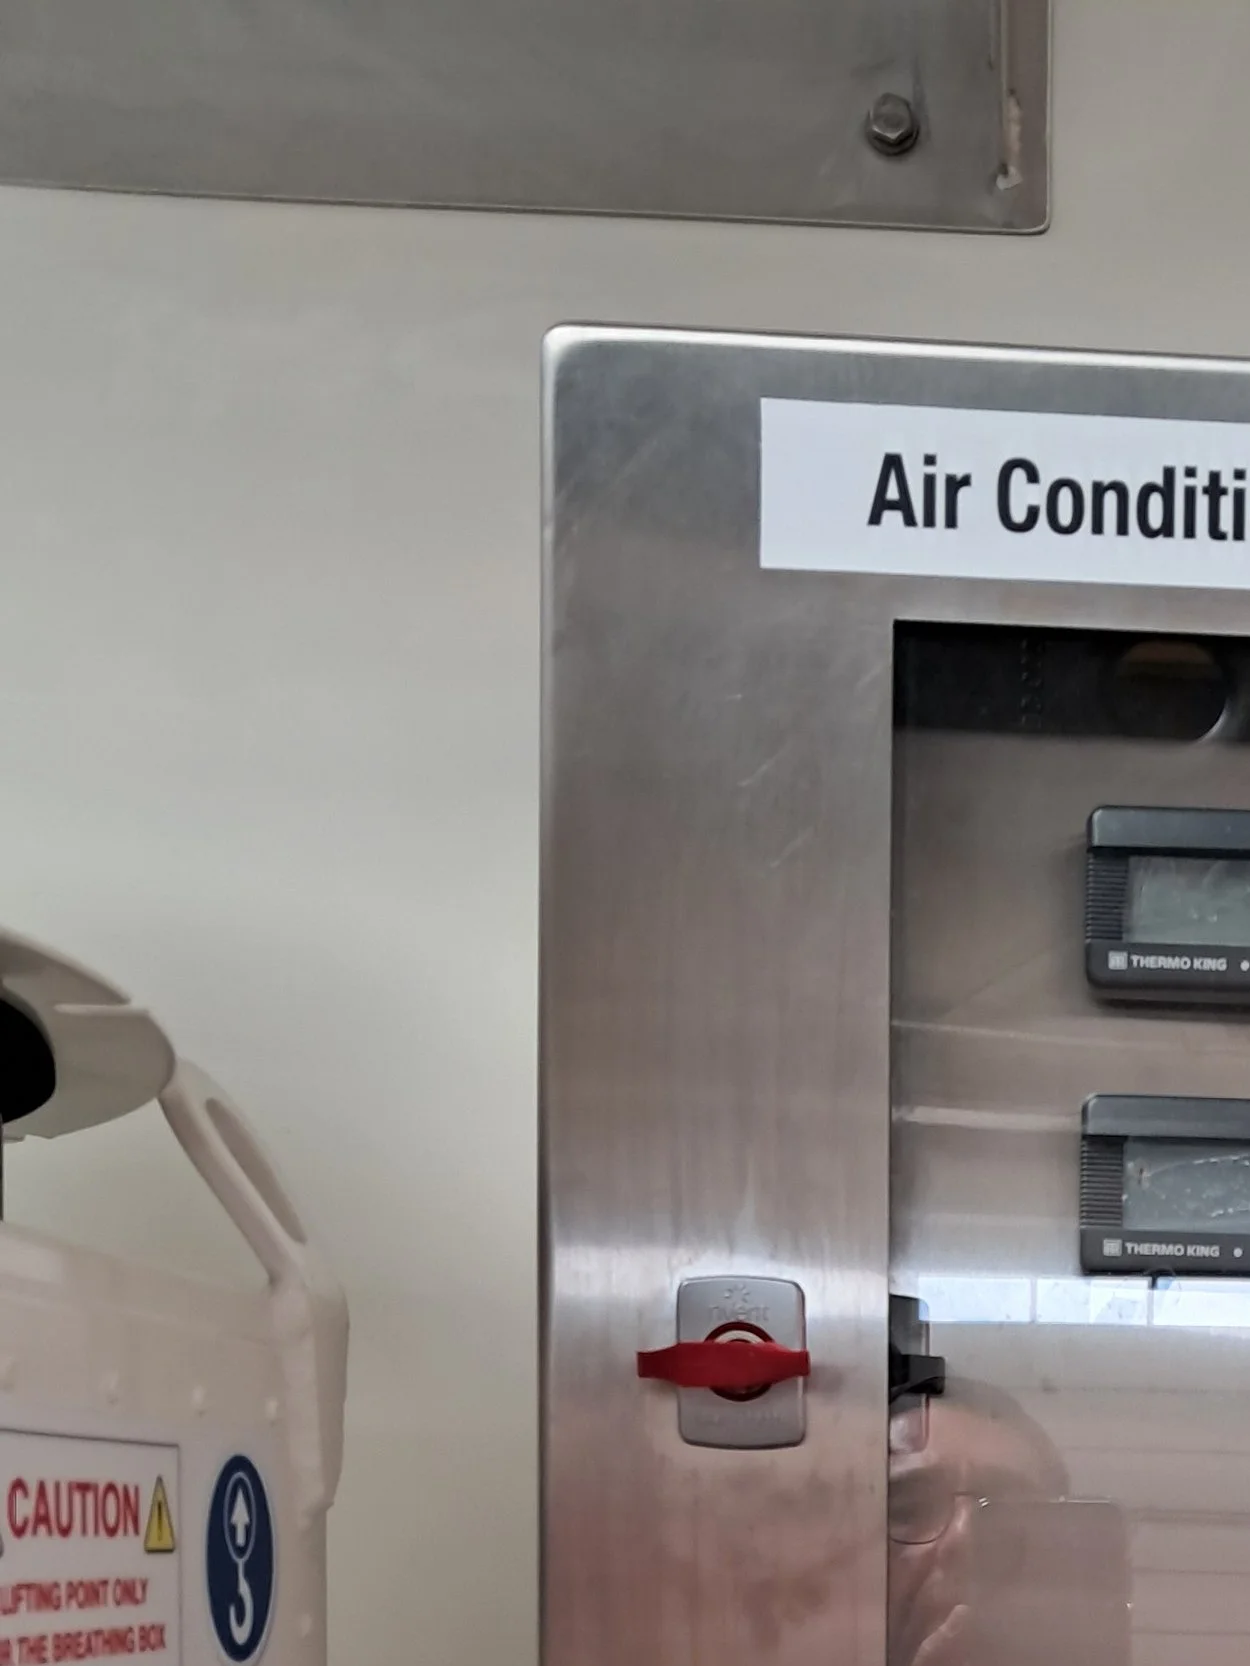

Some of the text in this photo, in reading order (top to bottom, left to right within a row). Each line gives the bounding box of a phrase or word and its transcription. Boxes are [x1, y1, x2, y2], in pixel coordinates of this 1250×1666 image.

[867, 453, 972, 533] Air
[1131, 954, 1227, 971] THERMO KING
[1125, 1242, 1220, 1257] THERMO KING
[8, 1477, 140, 1539] CAUTION
[66, 1580, 109, 1609] POINT
[113, 1578, 148, 1606] ONLY
[18, 1635, 48, 1665] THE
[52, 1627, 134, 1662] BREATHING
[138, 1624, 166, 1651] BOX
